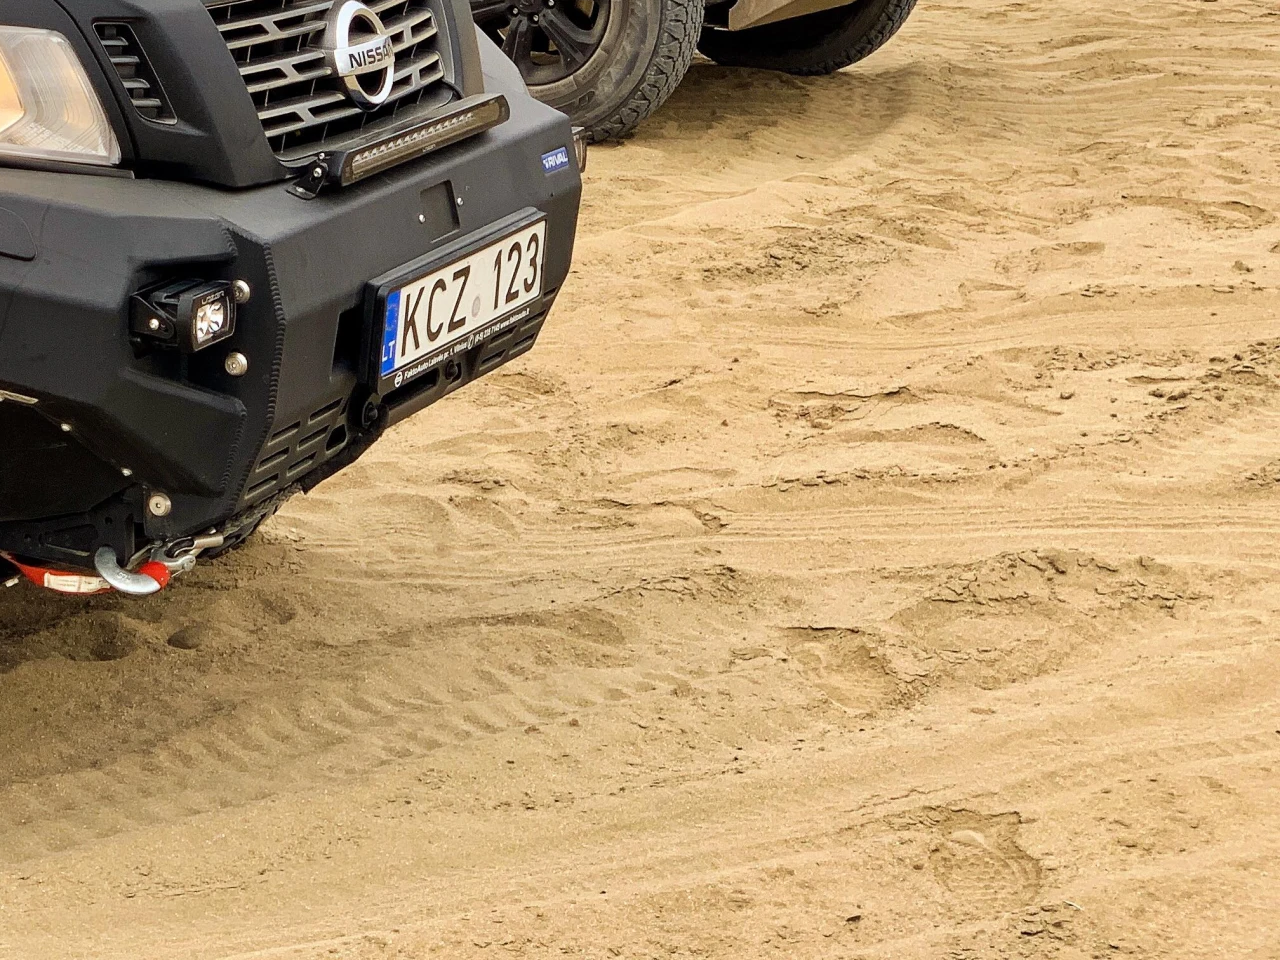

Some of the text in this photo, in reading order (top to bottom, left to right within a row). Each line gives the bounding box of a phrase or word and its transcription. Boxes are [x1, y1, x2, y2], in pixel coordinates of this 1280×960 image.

[400, 232, 540, 358] KCZ 123
[381, 340, 396, 362] LT
